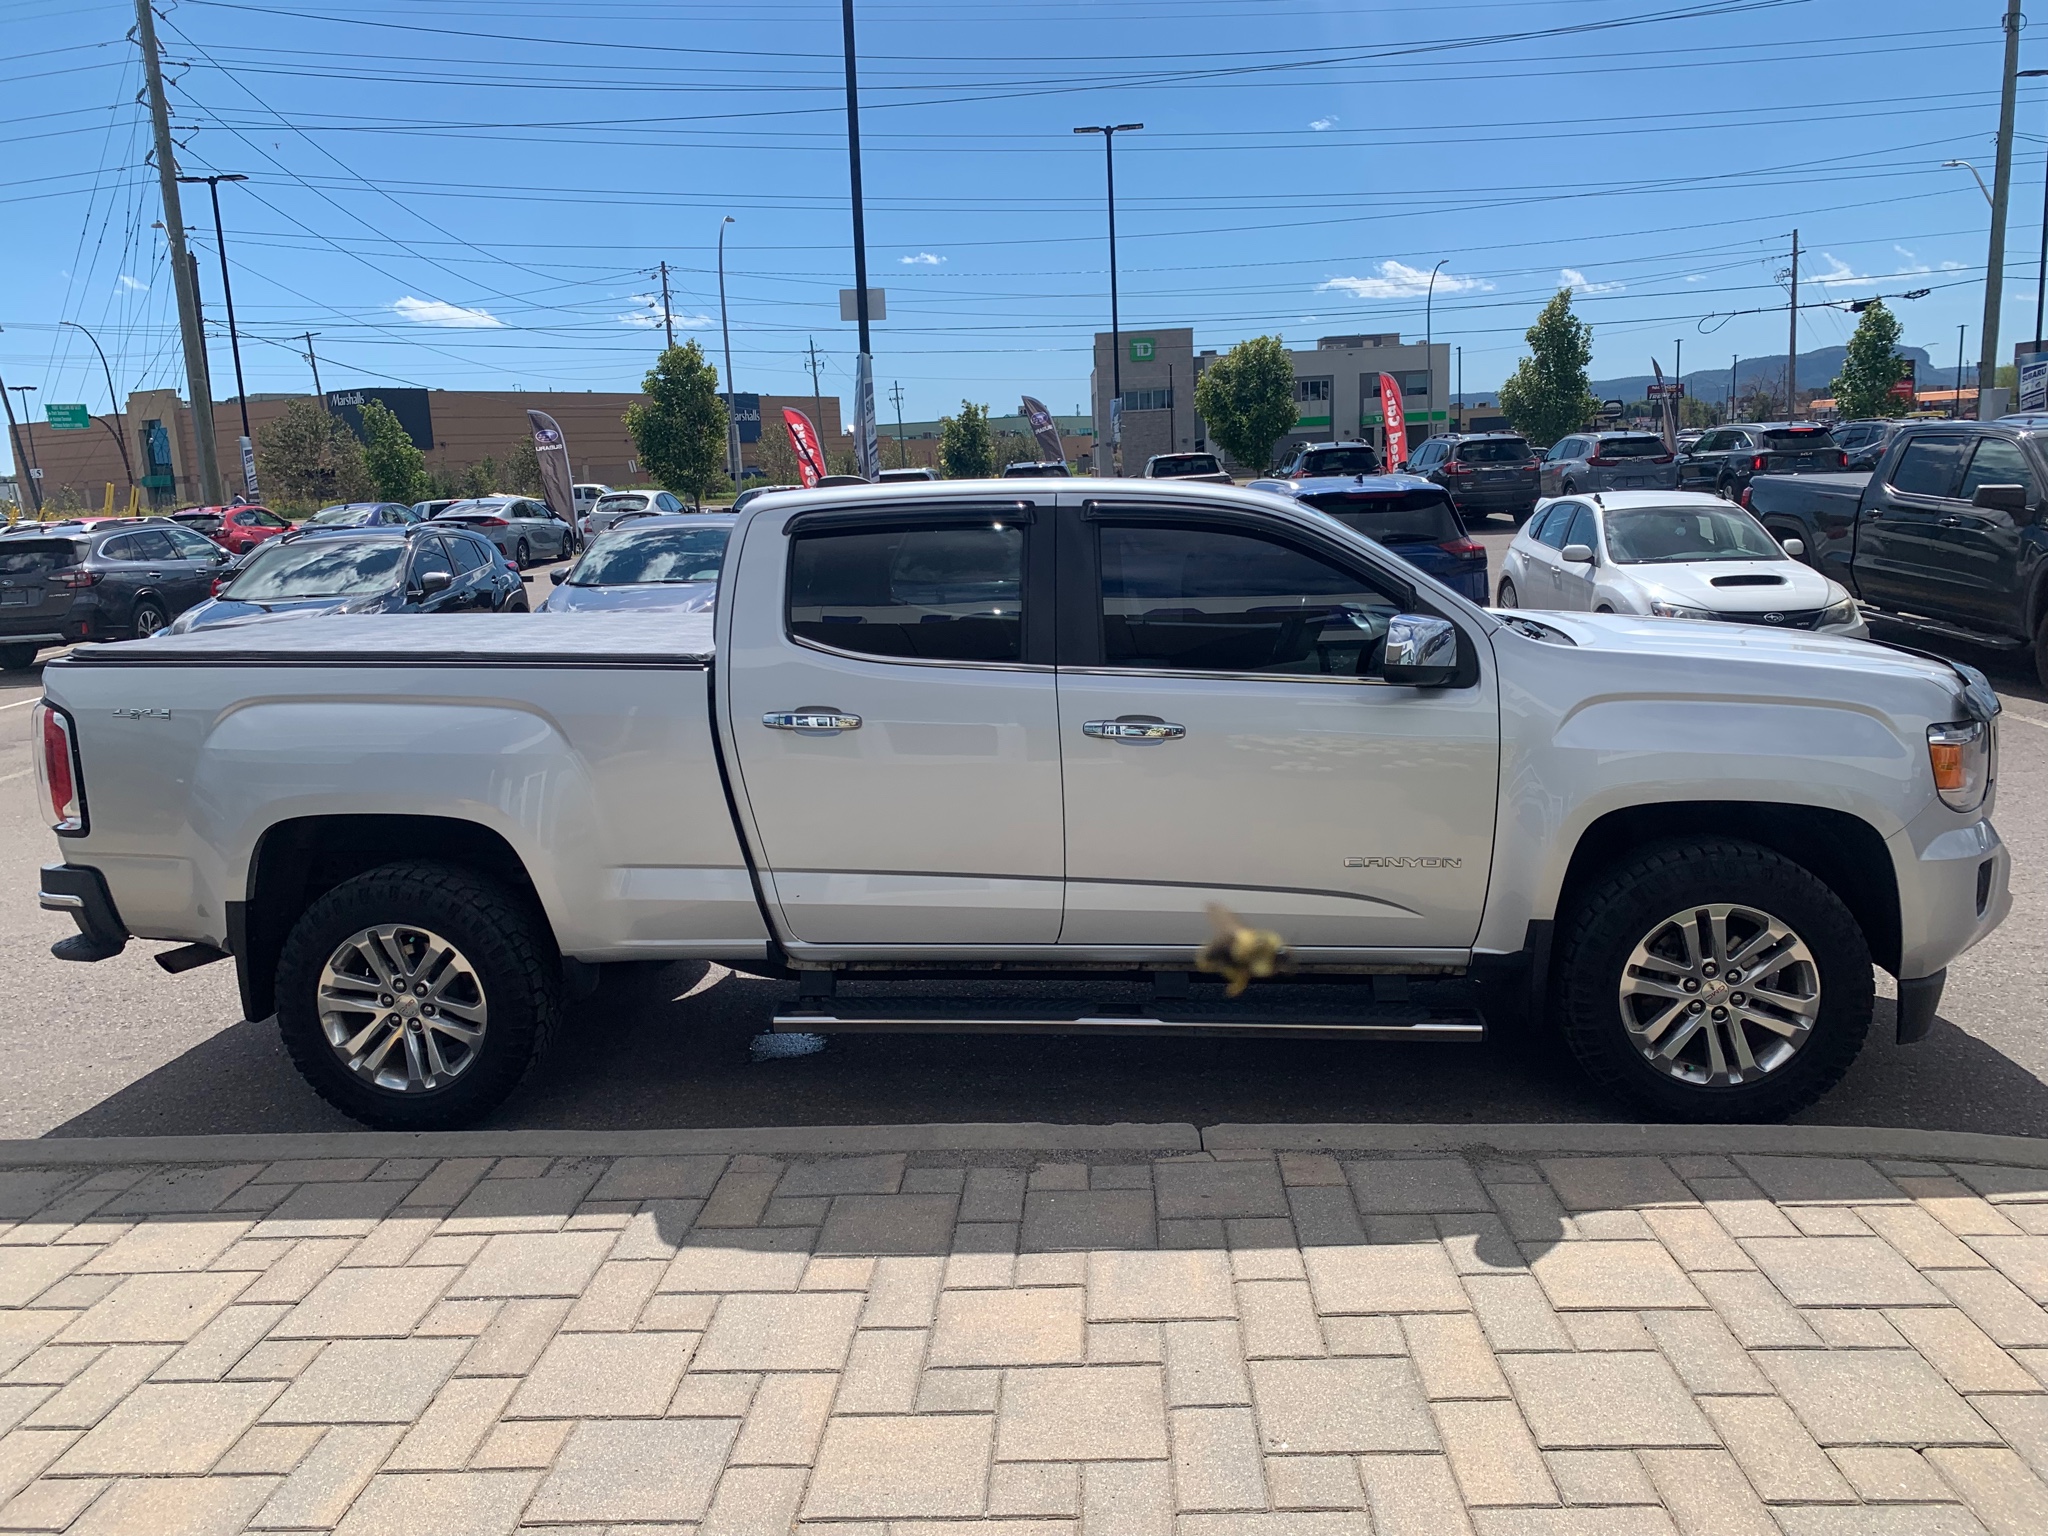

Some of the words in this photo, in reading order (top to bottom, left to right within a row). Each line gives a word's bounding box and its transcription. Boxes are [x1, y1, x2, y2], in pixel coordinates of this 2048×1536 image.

[1133, 342, 1152, 357] TD
[331, 391, 365, 407] Marshalls
[734, 409, 760, 421] arshalls
[1343, 856, 1462, 869] CANYON
[1704, 984, 1726, 1001] GMC
